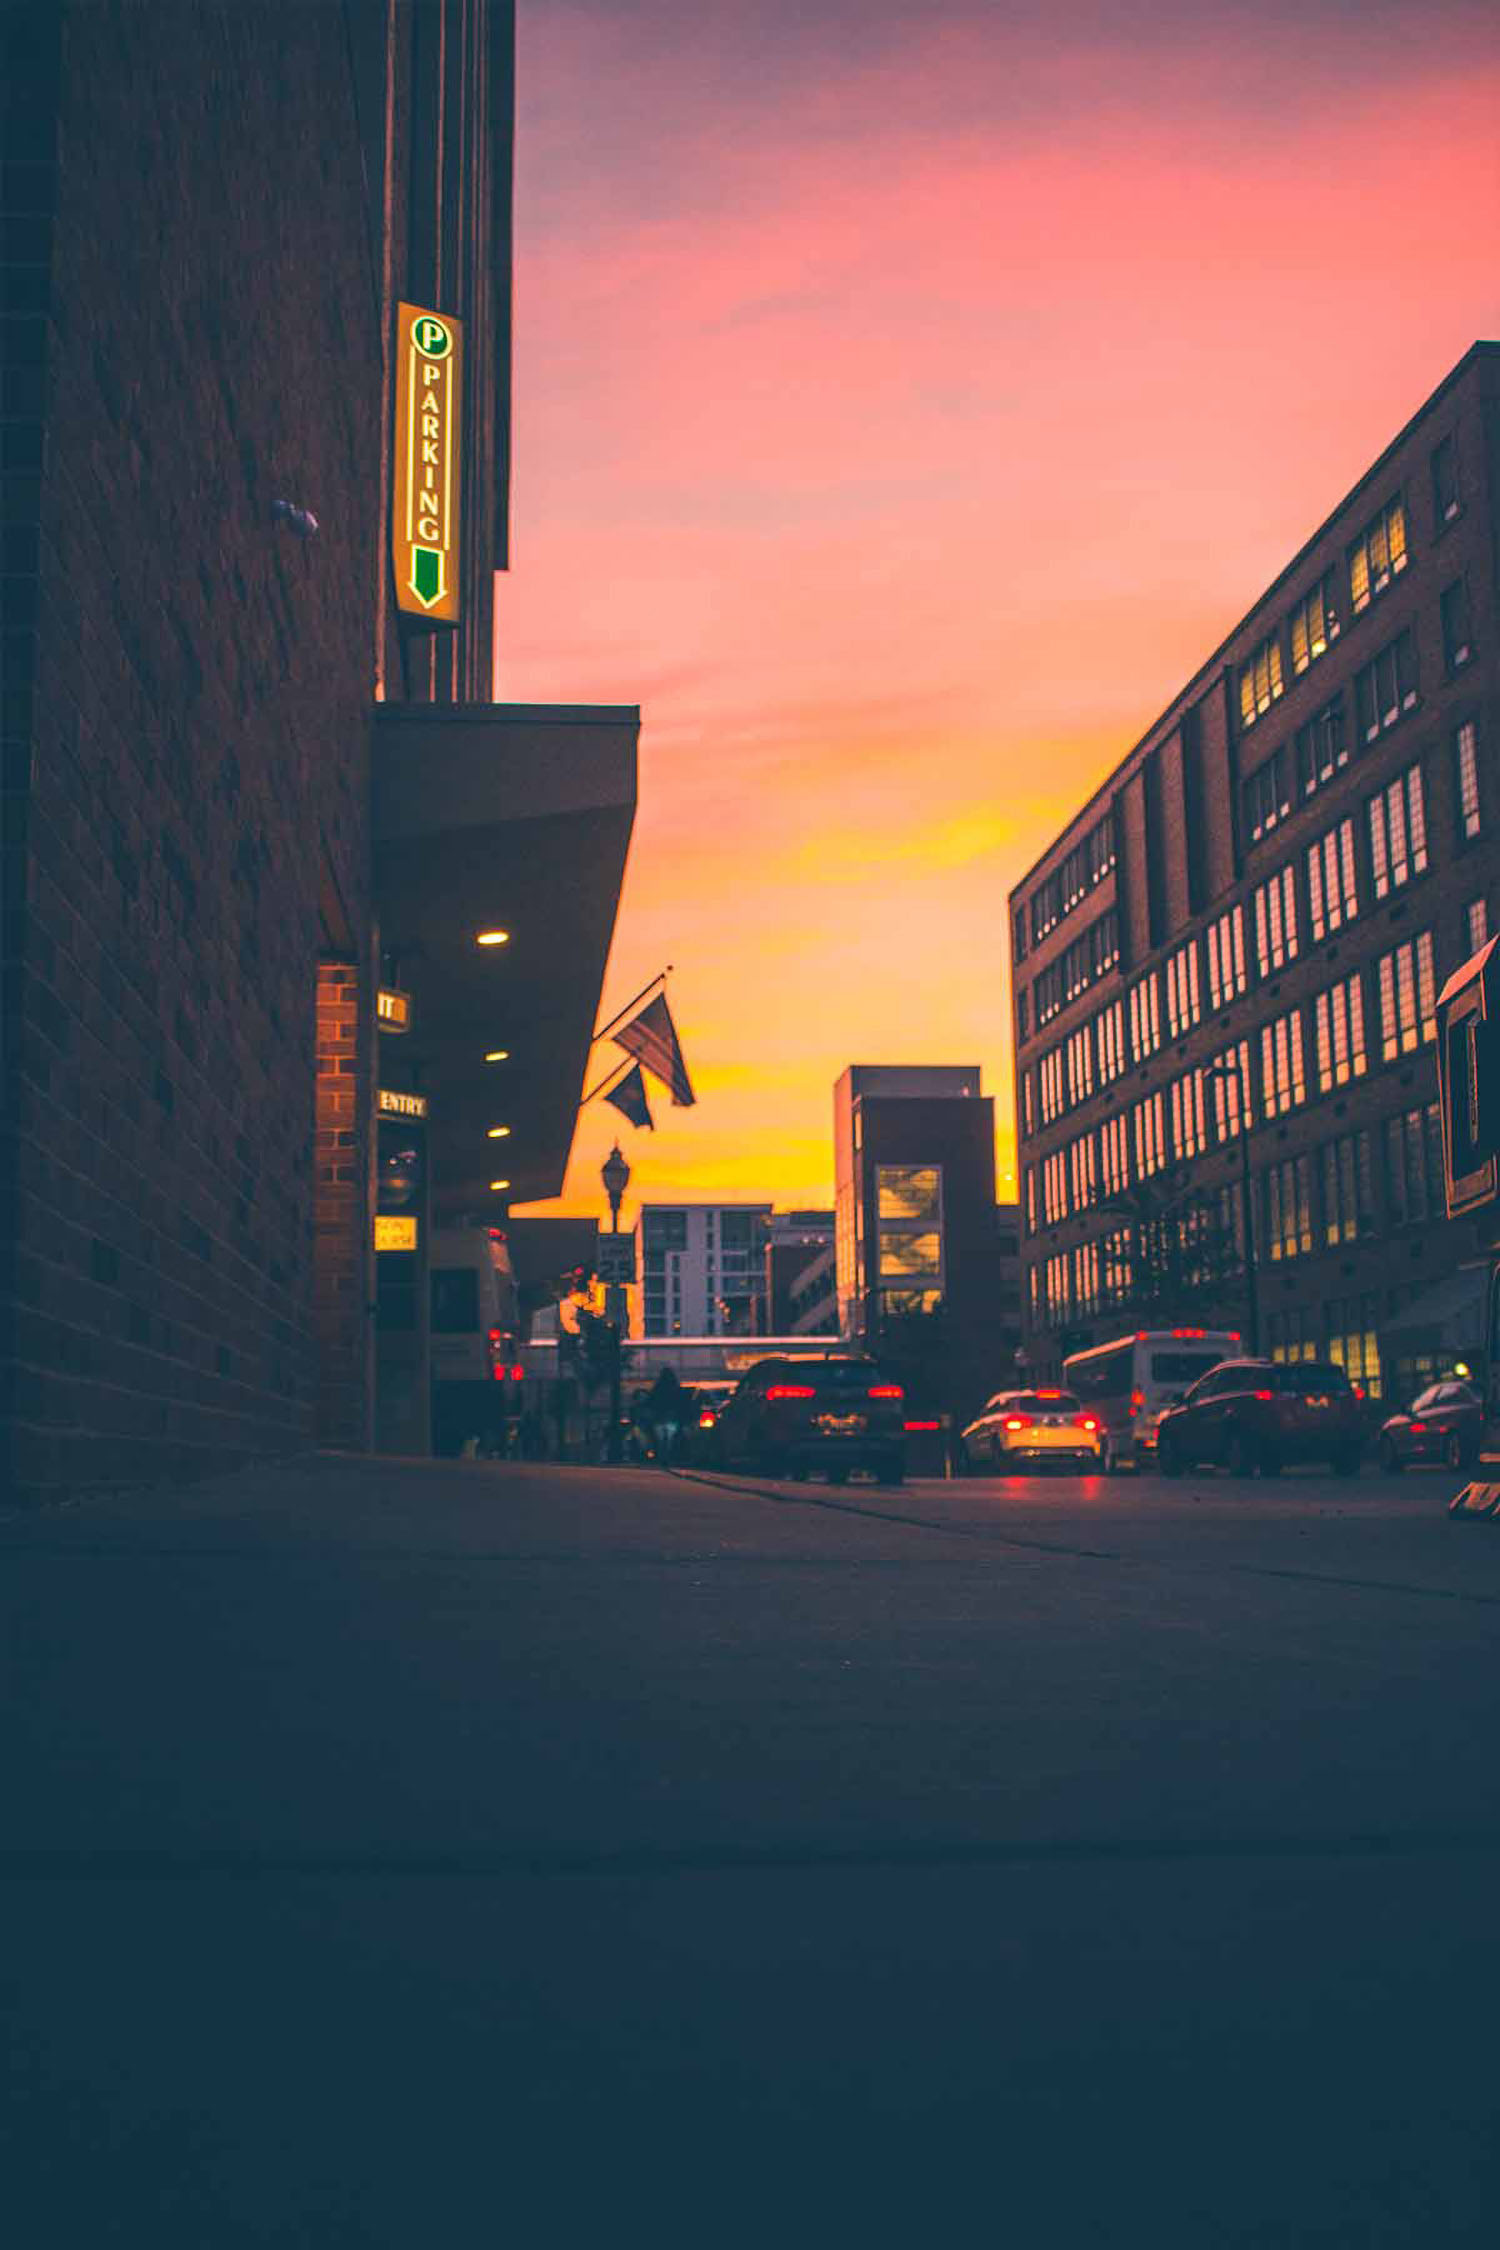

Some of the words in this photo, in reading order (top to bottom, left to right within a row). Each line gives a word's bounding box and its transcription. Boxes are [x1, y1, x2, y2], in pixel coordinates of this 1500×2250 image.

[423, 321, 444, 350] P
[418, 363, 440, 541] PARKING
[380, 1091, 425, 1117] ENTRY
[600, 1260, 633, 1280] 25
